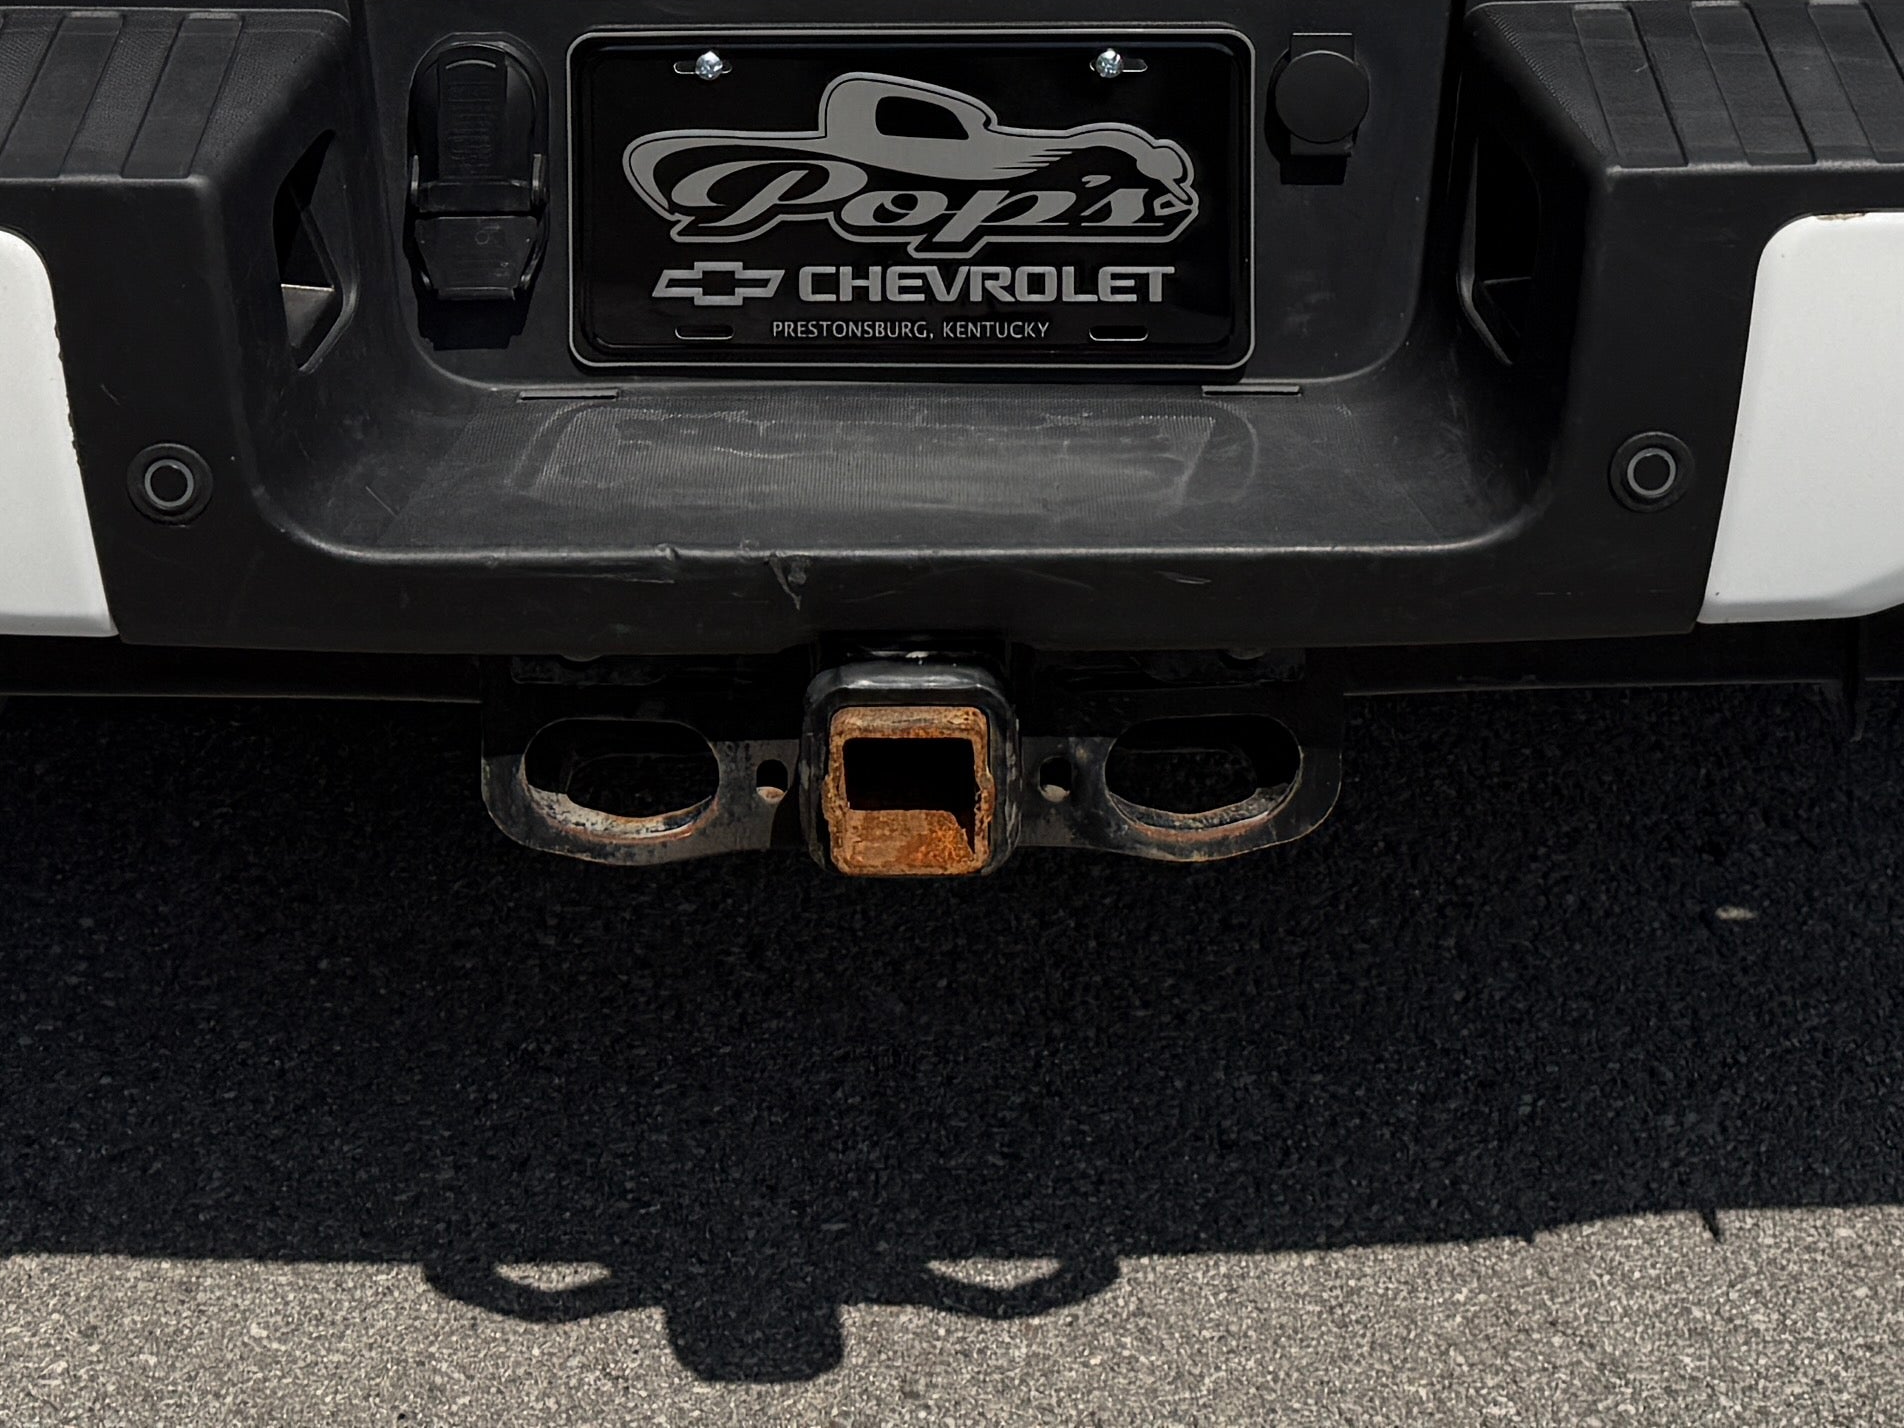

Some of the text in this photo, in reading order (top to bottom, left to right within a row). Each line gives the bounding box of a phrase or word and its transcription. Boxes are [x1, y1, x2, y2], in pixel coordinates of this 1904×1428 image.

[669, 157, 1168, 244] Pop's
[797, 265, 1176, 304] CHEVROLET
[772, 320, 1050, 341] PRESTONSBURG, KENTUCKY
